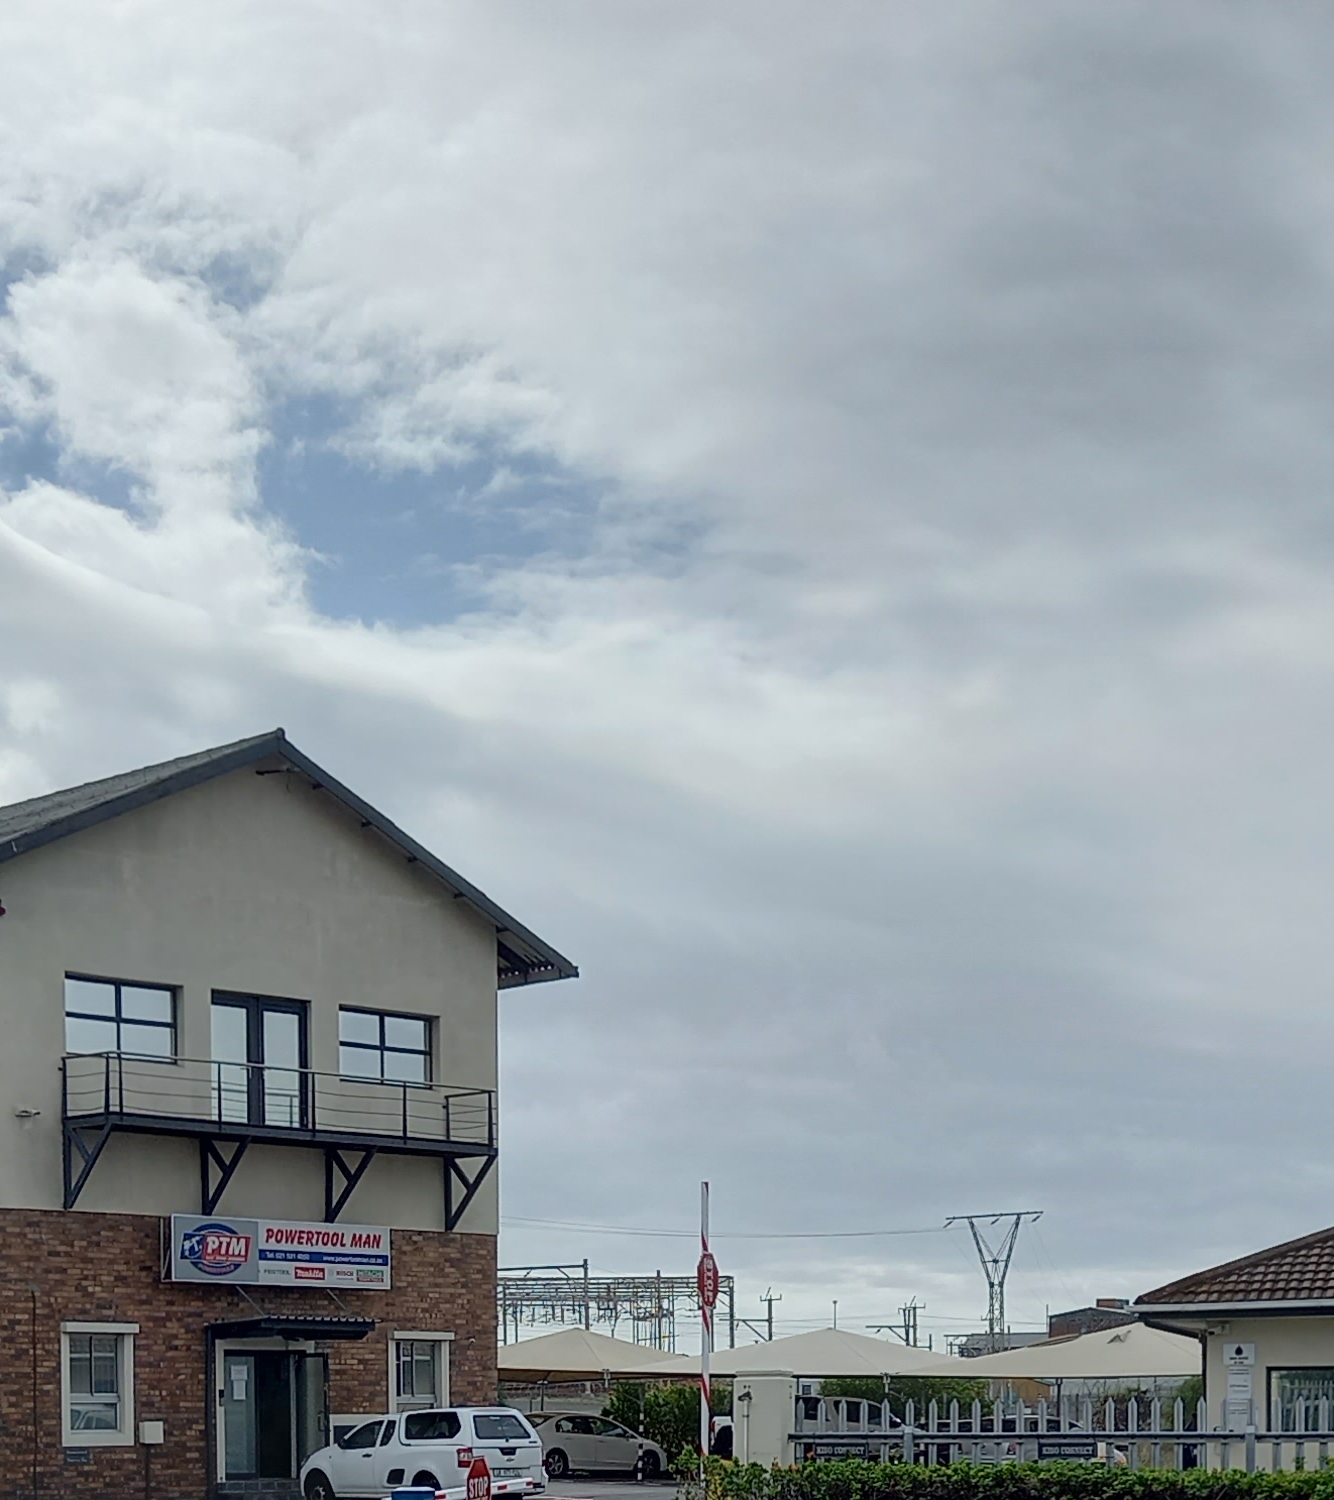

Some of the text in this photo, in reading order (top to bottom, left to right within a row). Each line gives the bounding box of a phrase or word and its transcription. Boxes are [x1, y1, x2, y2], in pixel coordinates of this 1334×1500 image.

[205, 1235, 247, 1257] PTM
[265, 1228, 383, 1250] POWERTOOL MAN
[468, 1475, 489, 1499] STOP
